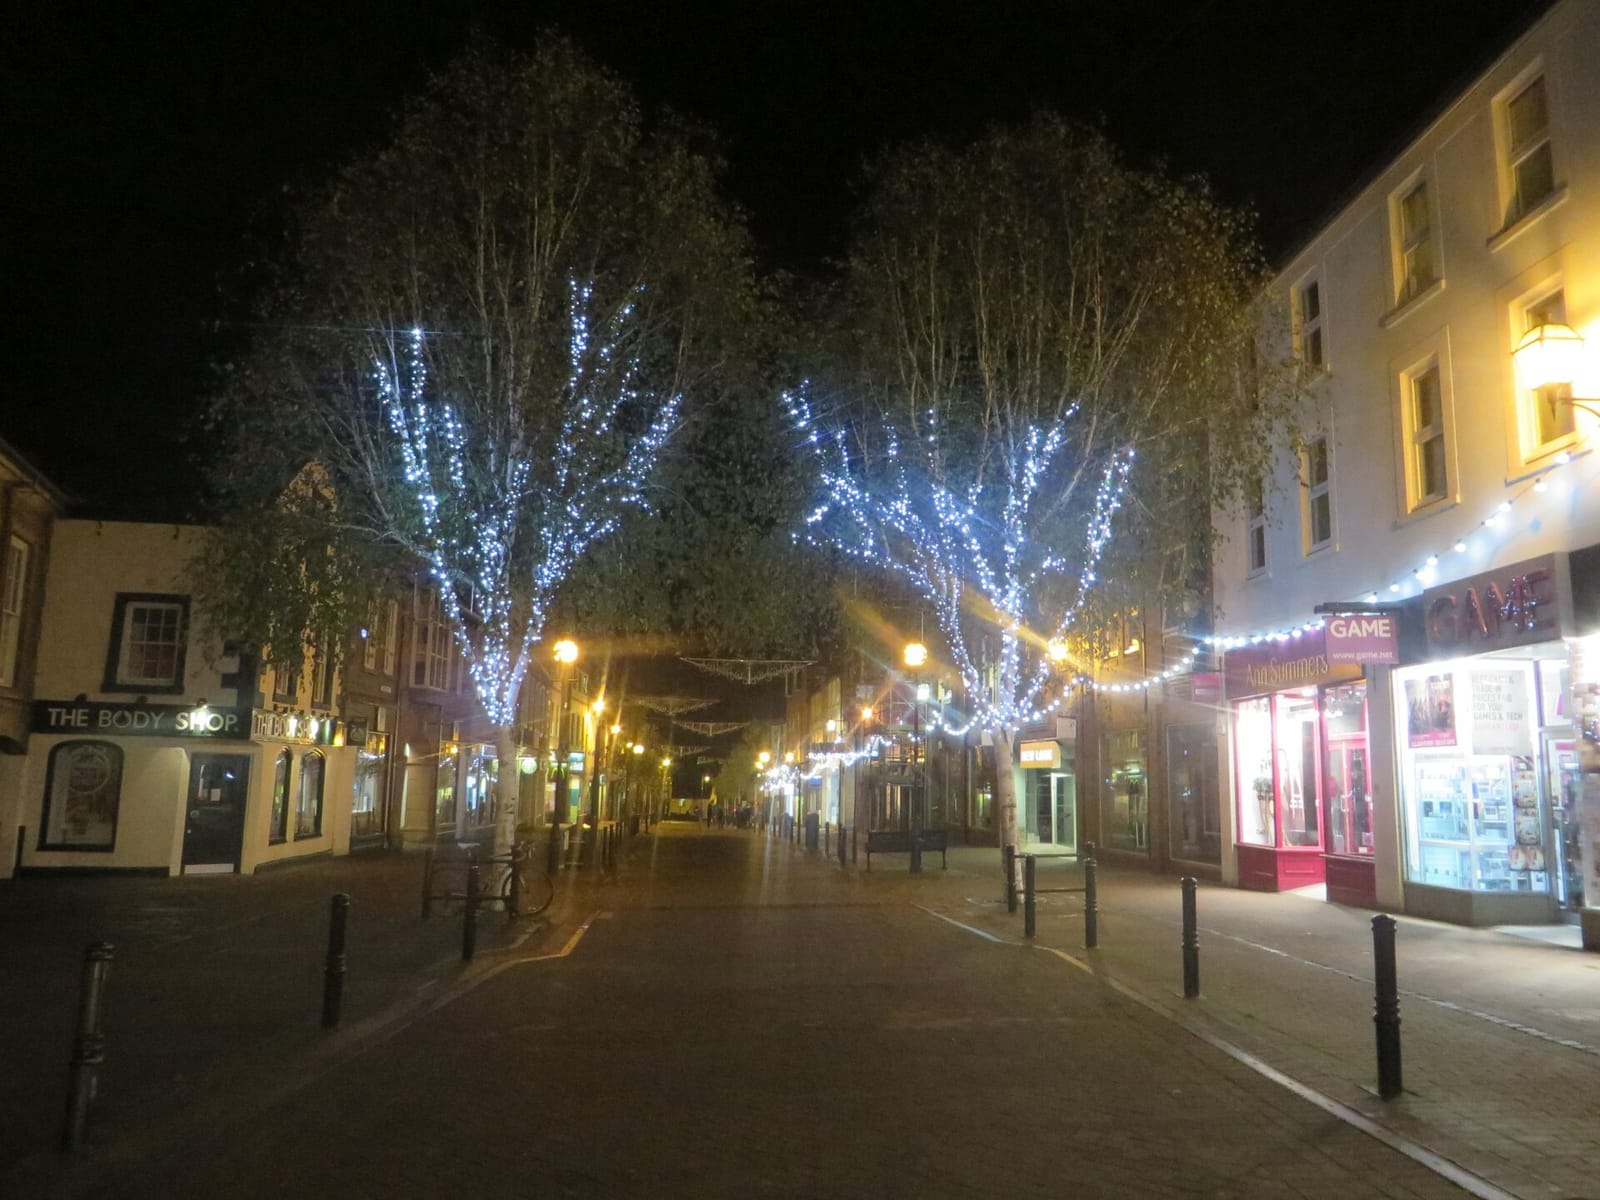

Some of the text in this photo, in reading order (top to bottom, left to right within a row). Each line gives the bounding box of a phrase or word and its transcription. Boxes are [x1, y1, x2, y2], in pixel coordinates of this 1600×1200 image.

[1330, 619, 1391, 638] GAME
[1247, 654, 1329, 687] Ann Summers
[48, 708, 238, 731] THE BODY SHOP
